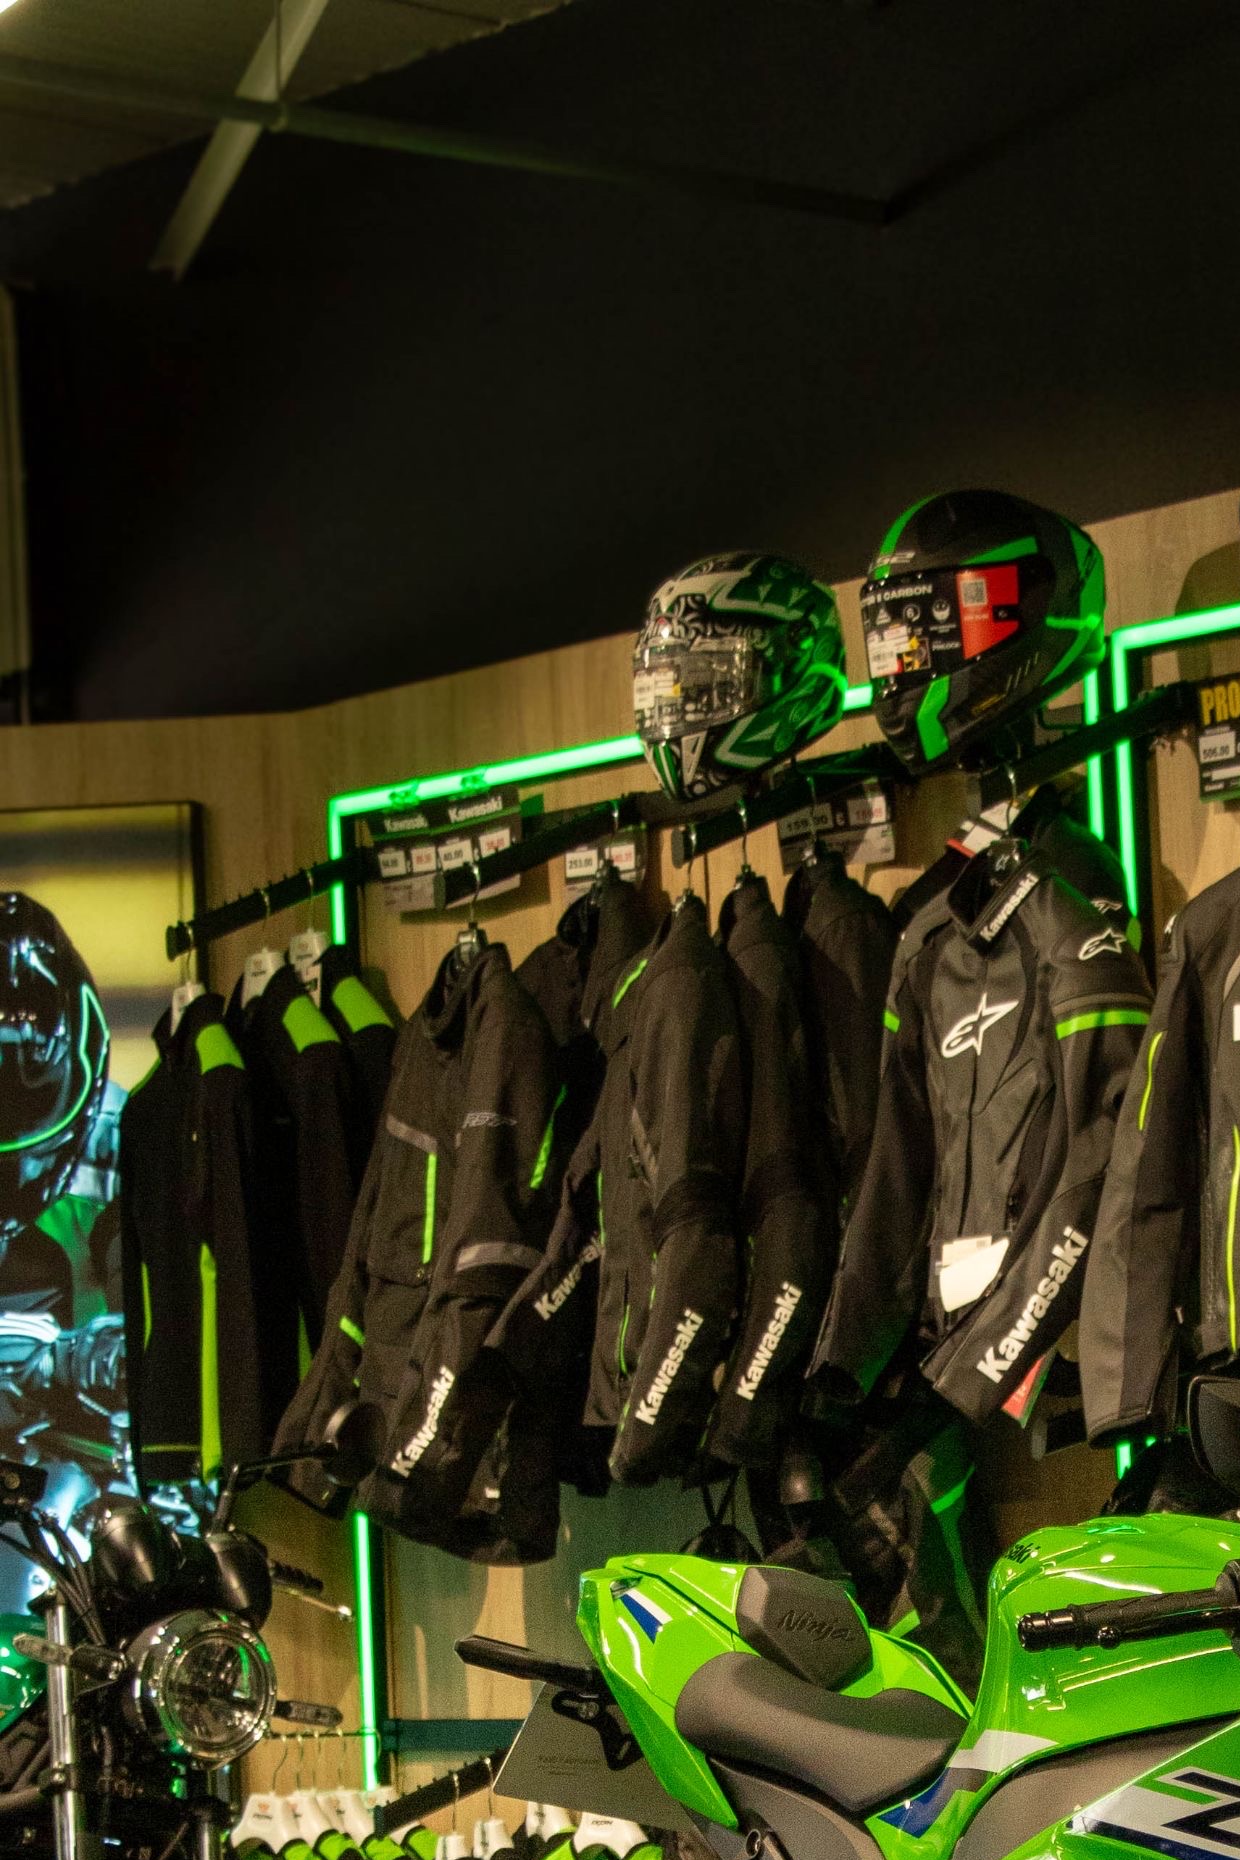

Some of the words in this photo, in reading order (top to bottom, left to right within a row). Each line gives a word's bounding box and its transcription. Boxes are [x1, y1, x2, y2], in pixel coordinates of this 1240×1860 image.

[883, 584, 933, 602] CARBON
[448, 796, 503, 824] Kawasaki
[979, 872, 1040, 942] Kawasaki
[736, 1281, 802, 1401] Kawasaki
[976, 1225, 1089, 1384] Kawasaki
[391, 1365, 456, 1479] Kawasaki
[635, 1308, 704, 1426] Kawasaki
